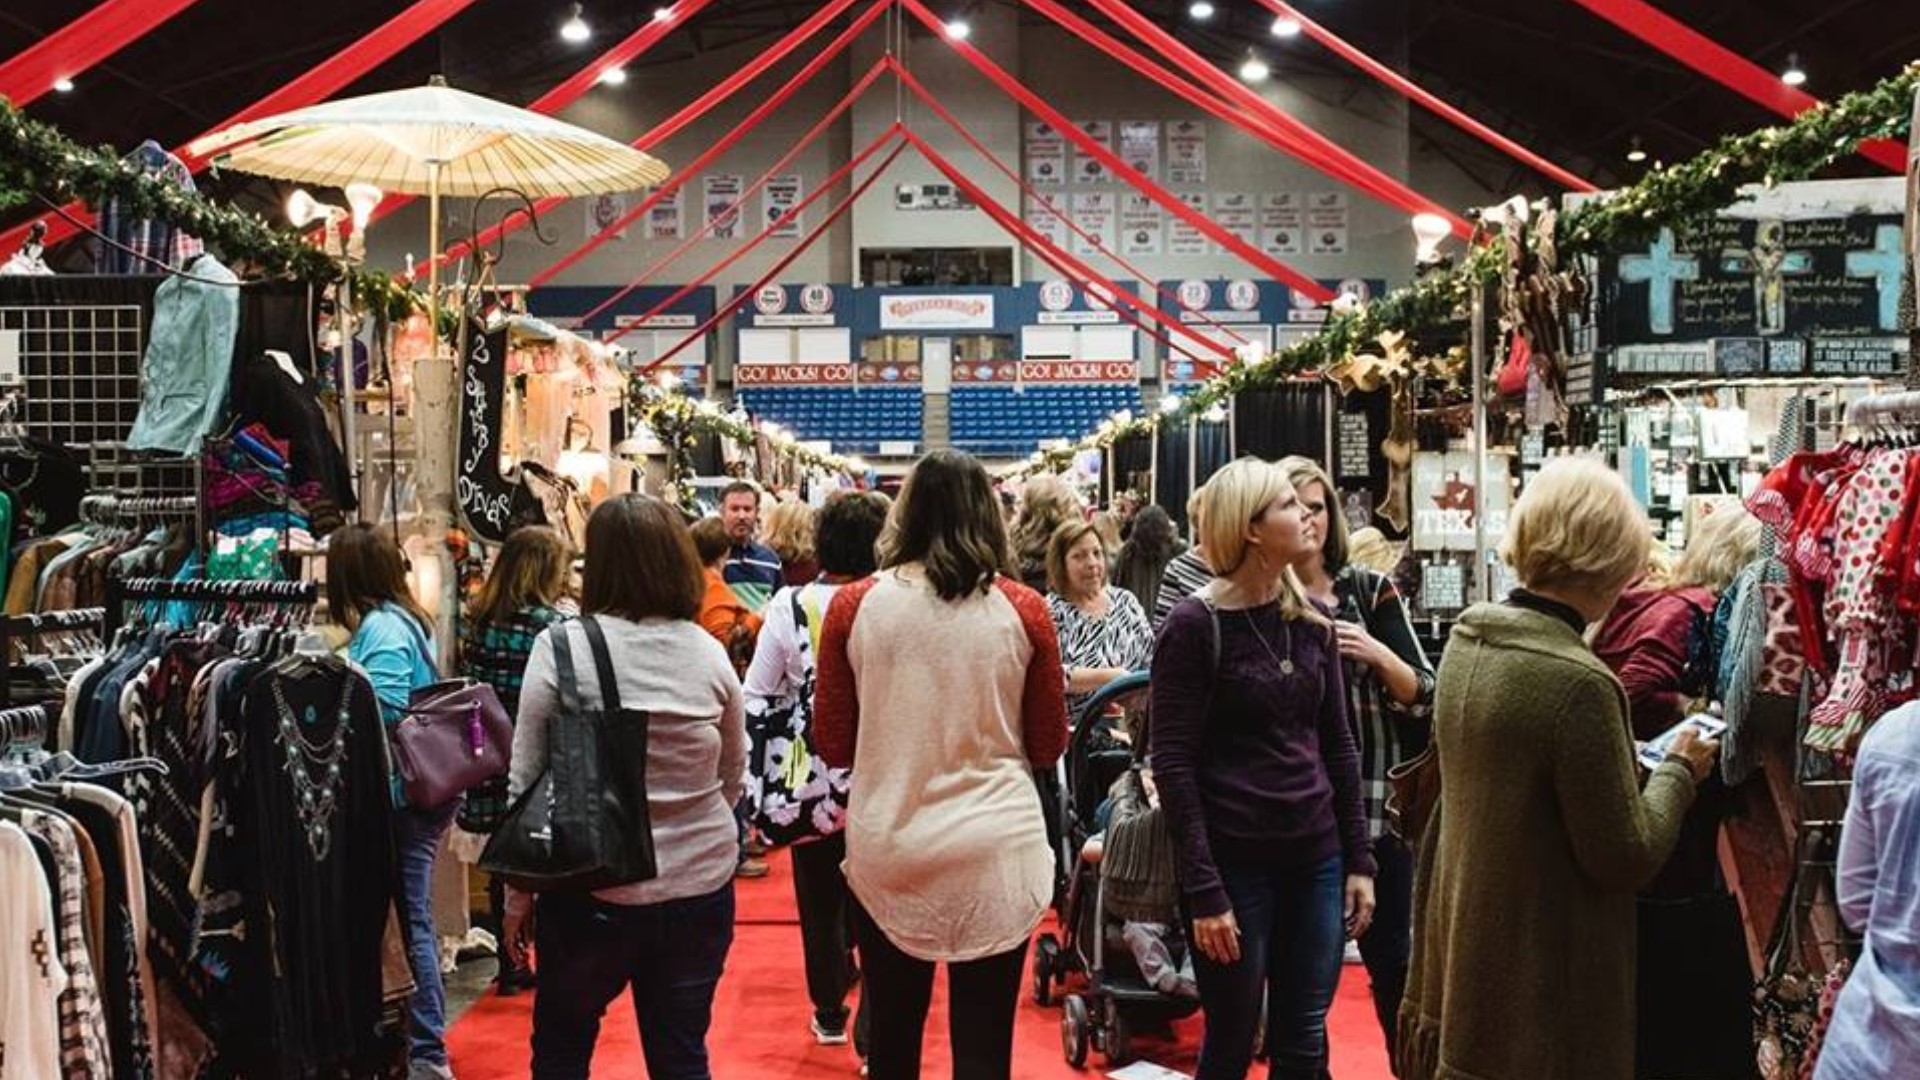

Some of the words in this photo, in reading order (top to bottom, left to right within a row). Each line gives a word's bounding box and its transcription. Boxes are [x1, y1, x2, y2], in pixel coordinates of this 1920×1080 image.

[738, 366, 767, 381] GO!
[771, 366, 818, 381] JACKS!
[823, 366, 852, 380] GO!
[1022, 364, 1050, 379] GO!
[1054, 364, 1101, 379] JACKS!
